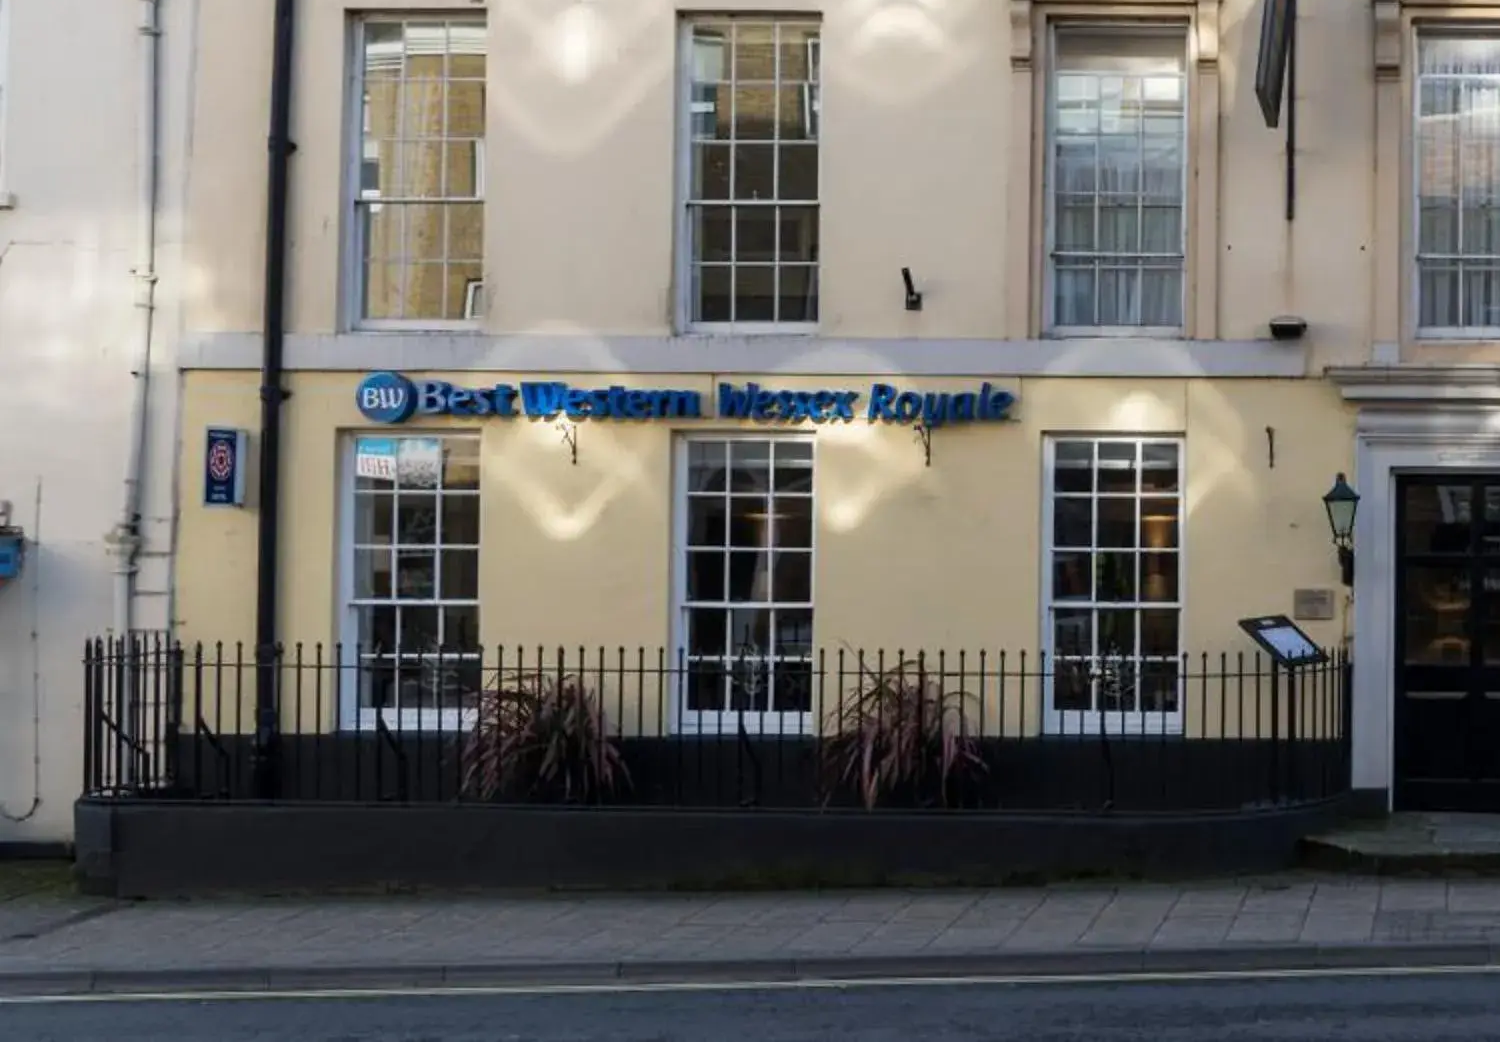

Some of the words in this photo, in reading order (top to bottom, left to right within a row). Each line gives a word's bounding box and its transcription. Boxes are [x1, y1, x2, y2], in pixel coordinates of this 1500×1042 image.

[362, 387, 404, 409] BW
[418, 381, 517, 418] Best
[520, 381, 704, 419] Western
[719, 382, 859, 423] Wessex
[867, 383, 1014, 429] Royale
